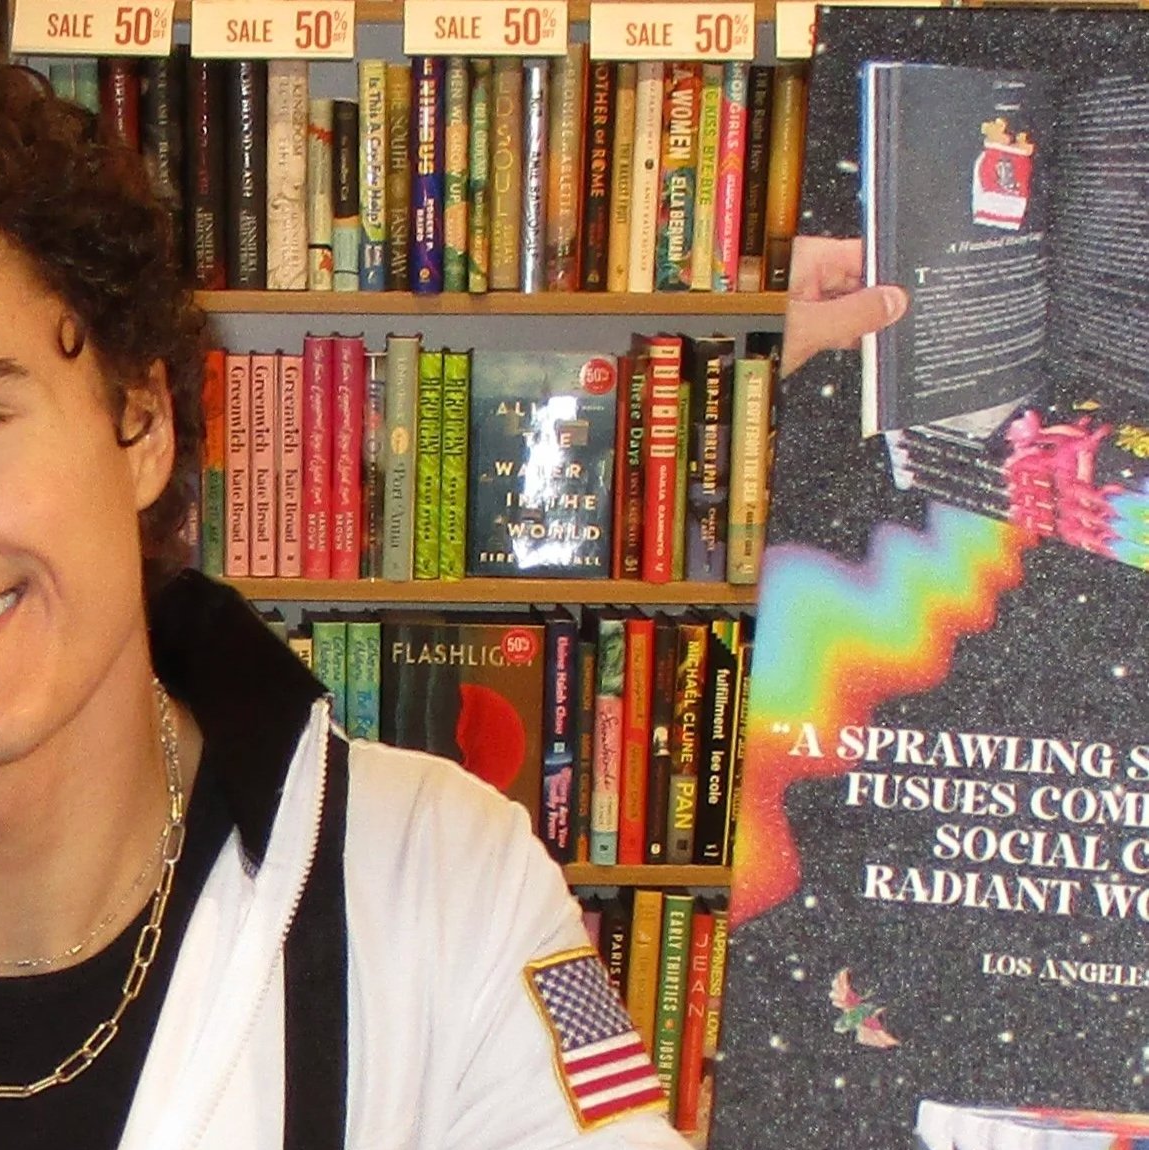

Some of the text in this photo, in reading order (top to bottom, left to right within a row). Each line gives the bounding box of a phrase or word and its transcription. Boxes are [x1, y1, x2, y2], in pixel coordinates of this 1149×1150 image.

[47, 14, 93, 38] SALE
[227, 19, 274, 43] SALE
[435, 16, 481, 39] SALE
[626, 23, 673, 46] SALE
[369, 91, 381, 118] This
[669, 90, 693, 159] WOMEN
[703, 105, 717, 137] KISS
[752, 109, 765, 140] Right
[370, 123, 380, 133] A
[417, 79, 436, 175] NIMBUS
[390, 84, 410, 247] THE SOUTH TASH
[590, 149, 605, 198] ROME
[366, 190, 380, 229] Help?
[449, 183, 462, 202] UP
[415, 209, 424, 242] BAIRD
[425, 198, 434, 239] ROBERT
[667, 176, 686, 261] ELLA BERMAN
[707, 358, 720, 374] WE
[230, 366, 245, 454] Greenwich
[254, 366, 270, 454] Greenwich
[283, 366, 299, 454] Greenwich
[628, 373, 644, 466] These Days
[522, 432, 572, 448] TE
[704, 424, 717, 459] WORLD
[745, 425, 760, 456] FROM
[658, 465, 666, 500] GIULIA
[703, 464, 716, 495] APART
[745, 459, 759, 480] THE
[232, 469, 245, 543] Kate Broad
[256, 469, 269, 543] Kate Broad
[285, 469, 298, 543] Kate Broad
[744, 482, 758, 502] SEA
[308, 513, 316, 550] BROWN
[317, 511, 326, 552] HANNAH
[335, 513, 343, 550] BROWN
[345, 511, 354, 552] HANNAH
[507, 522, 601, 541] WORLD
[391, 642, 534, 668] FLASHLIG
[555, 636, 568, 734] Elaine Hsieh Chou
[681, 641, 700, 763] MICHAEL CLUNE
[707, 669, 730, 805] fulfillment lee cole
[836, 725, 1115, 779] SPRAWLING
[674, 782, 695, 830] PAN
[846, 772, 1016, 817] FUSUES
[557, 806, 568, 848] Are You
[933, 823, 1109, 870] SOCIAL
[863, 865, 1081, 916] RADIANT
[610, 934, 624, 974] PARIS
[709, 919, 727, 996] HAPPINESS
[982, 954, 1033, 977] LOS
[659, 911, 684, 1068] EARLY THIRTIES JOSH
[688, 934, 709, 1018] JEAN
